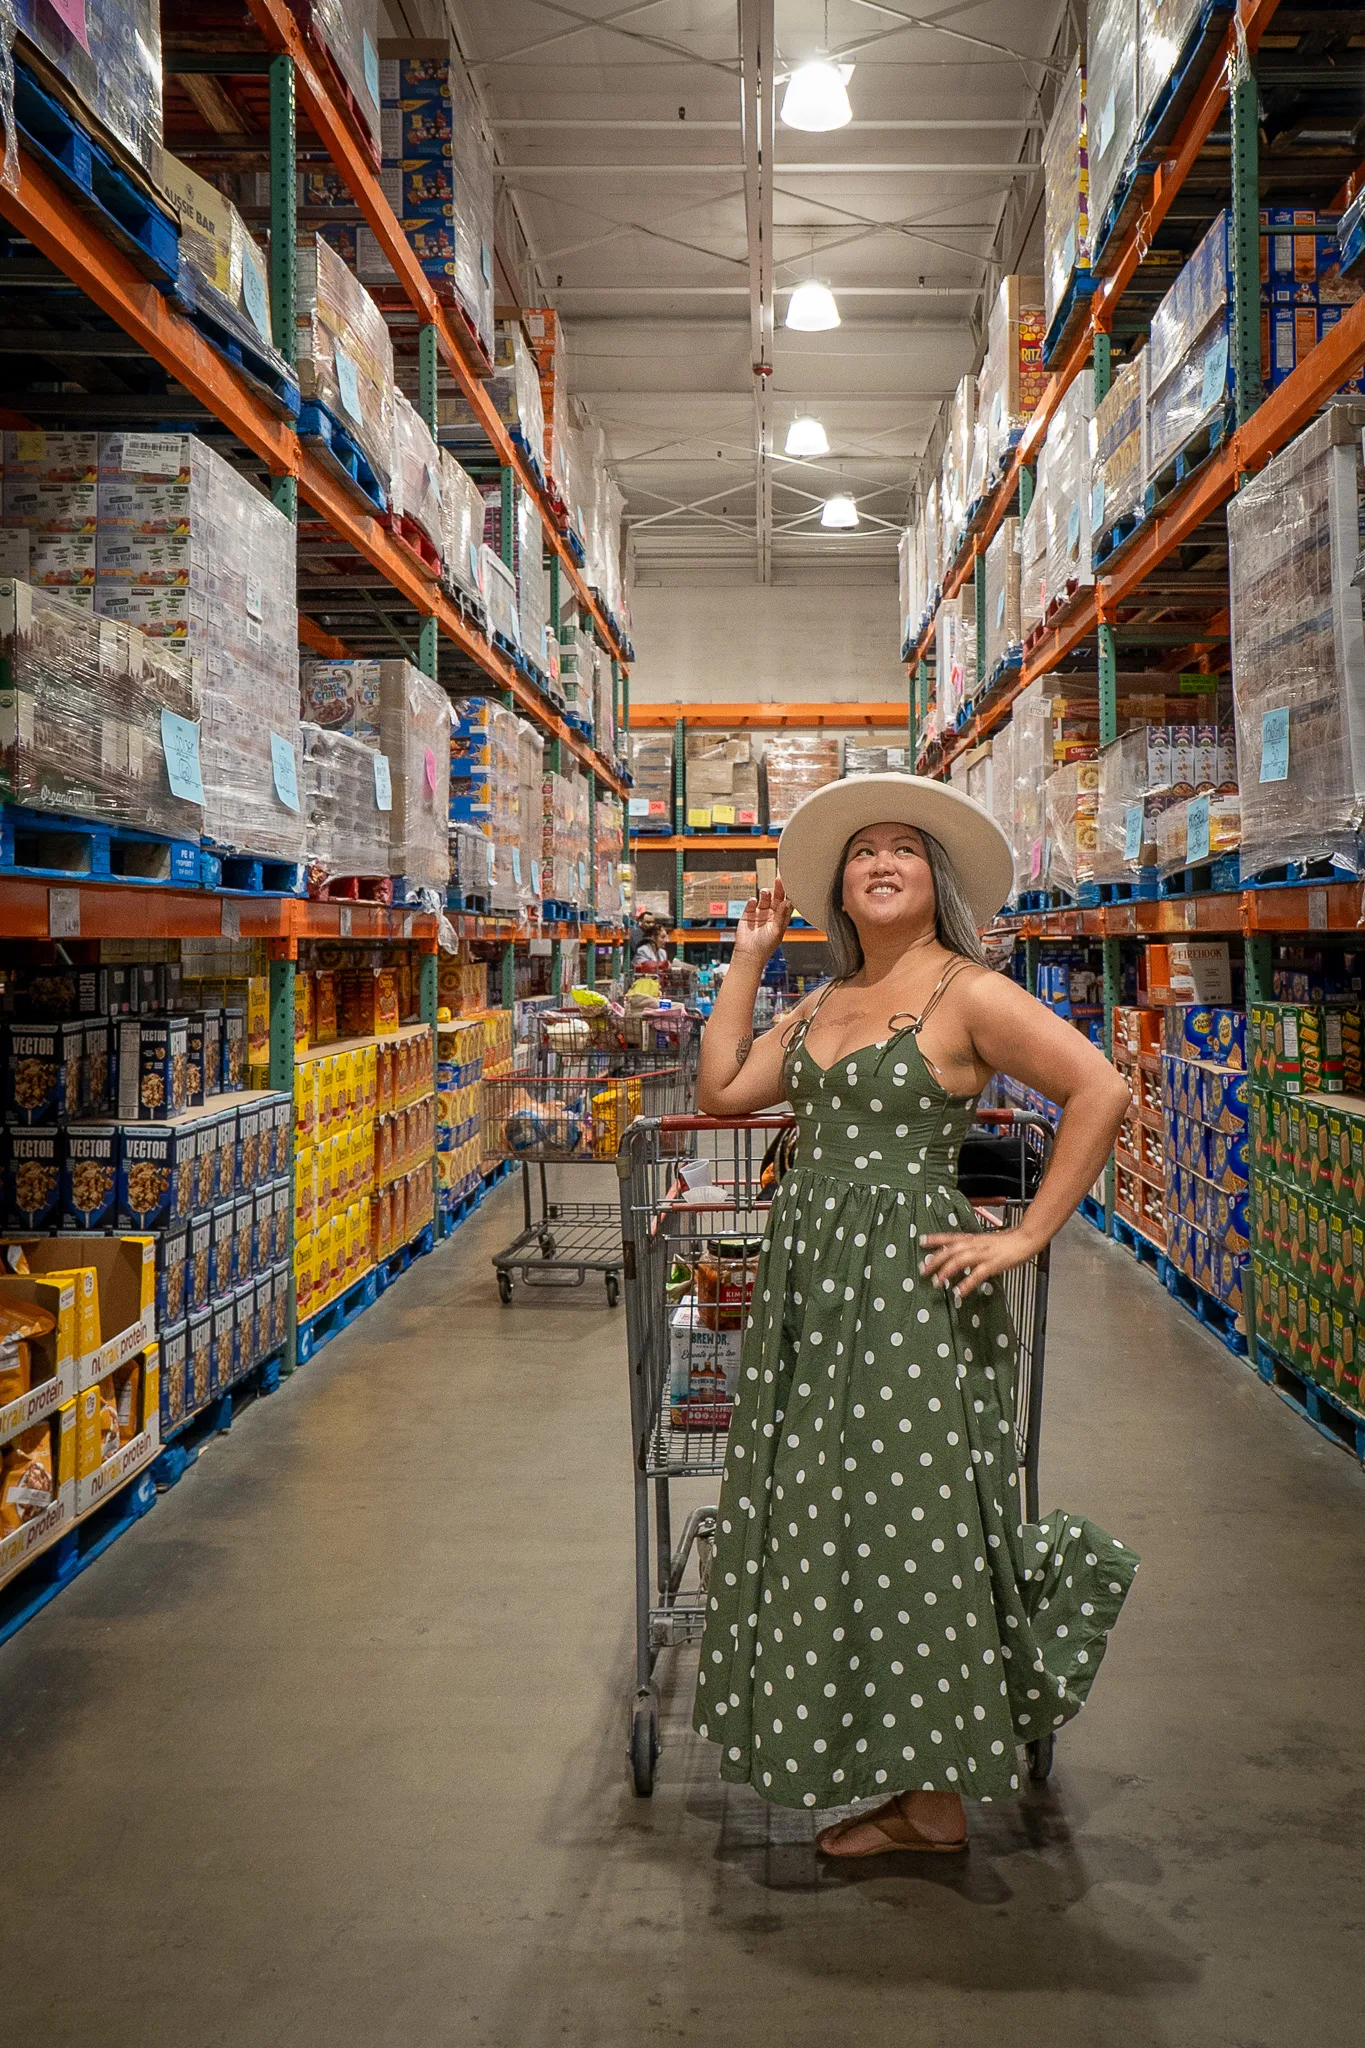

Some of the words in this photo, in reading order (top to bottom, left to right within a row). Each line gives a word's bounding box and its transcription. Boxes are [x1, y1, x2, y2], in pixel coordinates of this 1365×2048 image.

[164, 186, 194, 219] AUSSIE
[196, 210, 215, 235] BAR
[1021, 348, 1041, 361] RITZ
[312, 676, 346, 687] Cinnamon
[317, 682, 342, 692] Toast
[314, 687, 347, 700] Crunch
[1178, 949, 1222, 960] FIREHOOK
[141, 1030, 167, 1041] VECTOR
[12, 1036, 54, 1055] VECTOR
[13, 1140, 54, 1158] VECTOR
[70, 1140, 110, 1158] VECTOR
[126, 1140, 168, 1159] VECTOR
[120, 1320, 148, 1359] protein
[691, 1333, 714, 1346] BREW
[715, 1333, 730, 1346] DR.
[27, 1379, 64, 1421] protein
[122, 1433, 151, 1469] protein
[26, 1501, 64, 1551] protein
